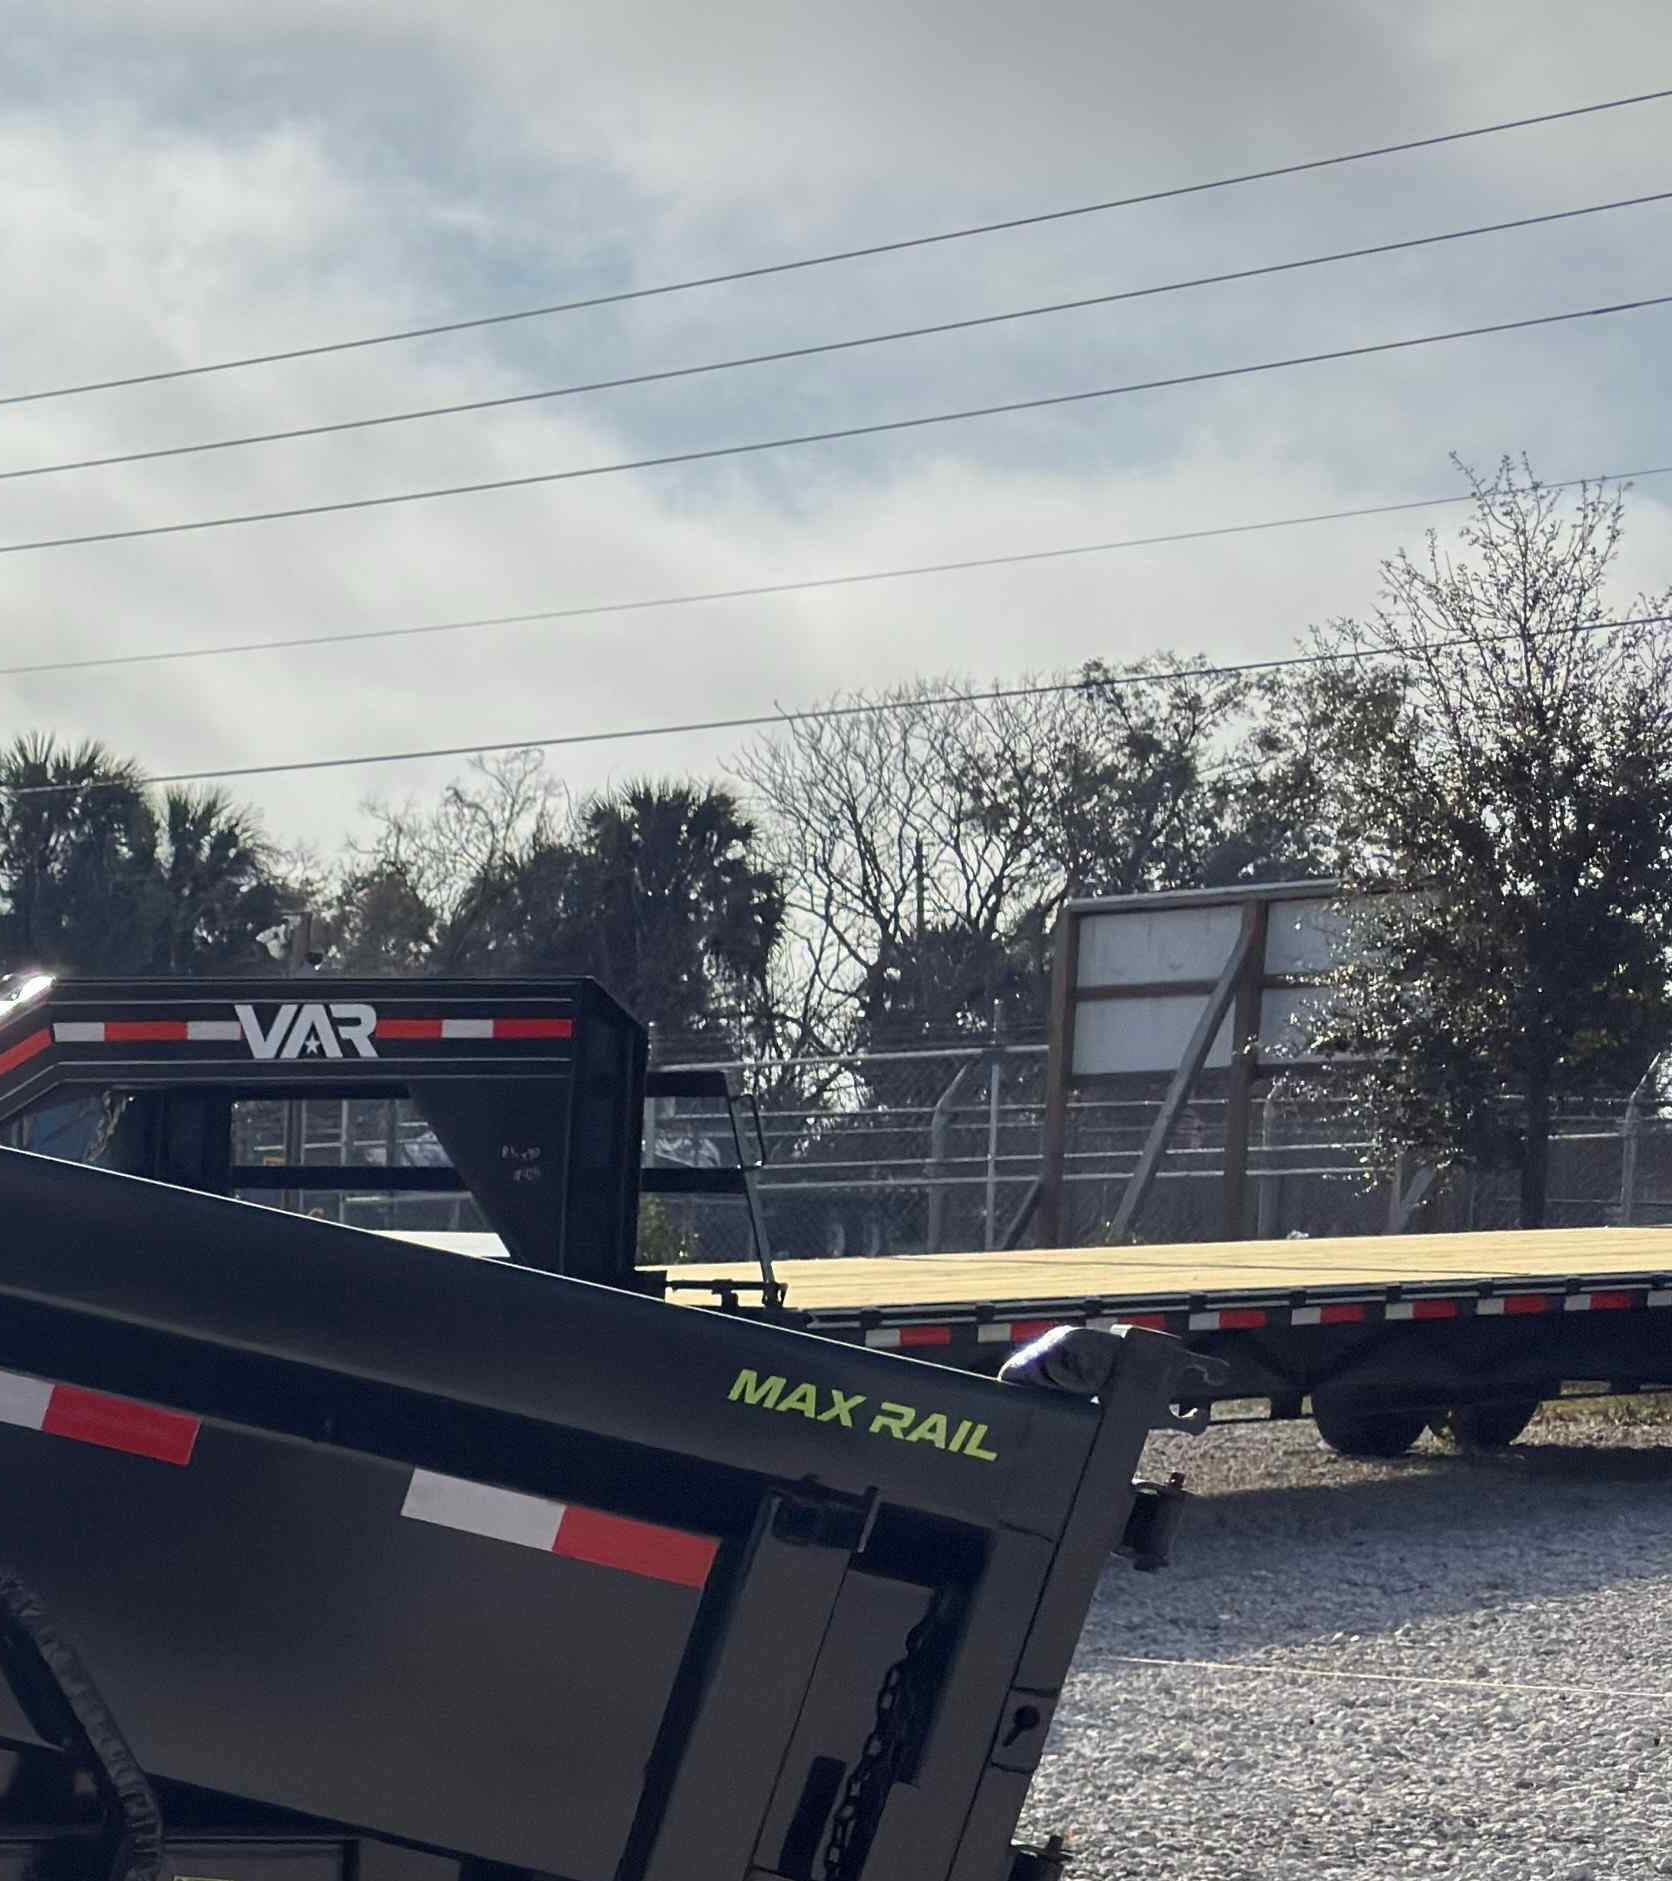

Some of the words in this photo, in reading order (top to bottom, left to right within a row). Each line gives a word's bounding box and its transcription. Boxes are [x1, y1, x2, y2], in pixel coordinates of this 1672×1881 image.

[234, 1003, 380, 1059] VAR
[727, 1368, 867, 1428] MAX
[868, 1401, 998, 1462] RAIL
